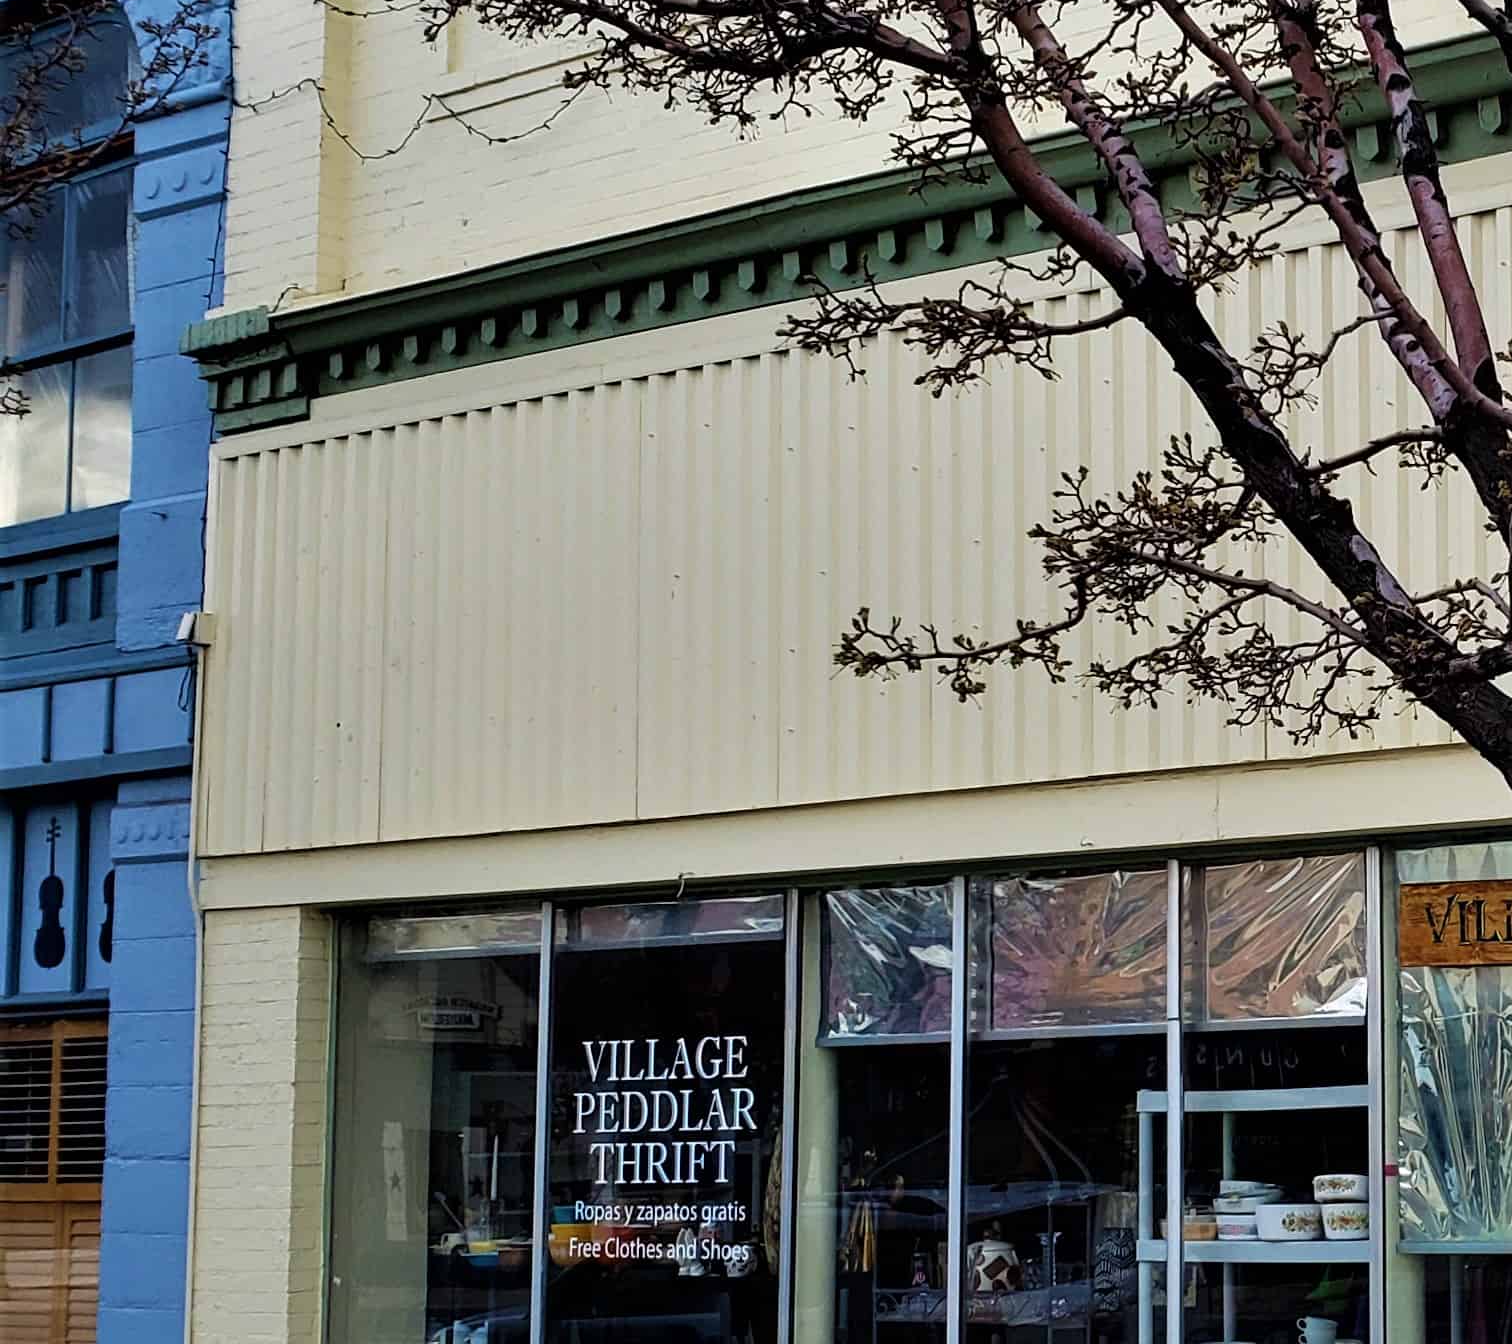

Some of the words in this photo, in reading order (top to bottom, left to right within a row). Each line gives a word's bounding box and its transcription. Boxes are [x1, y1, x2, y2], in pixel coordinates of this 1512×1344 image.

[582, 1036, 749, 1083] VILLAGE
[572, 1087, 758, 1134] PEDDLAR
[589, 1140, 736, 1184] THRIFT
[575, 1200, 621, 1226] Ropas
[624, 1205, 633, 1226] y
[636, 1202, 698, 1225] zapatos
[702, 1201, 746, 1226] gratis
[569, 1237, 601, 1258] Free
[605, 1237, 663, 1260] Clothes
[666, 1238, 697, 1260] and
[701, 1238, 749, 1261] Shoes
